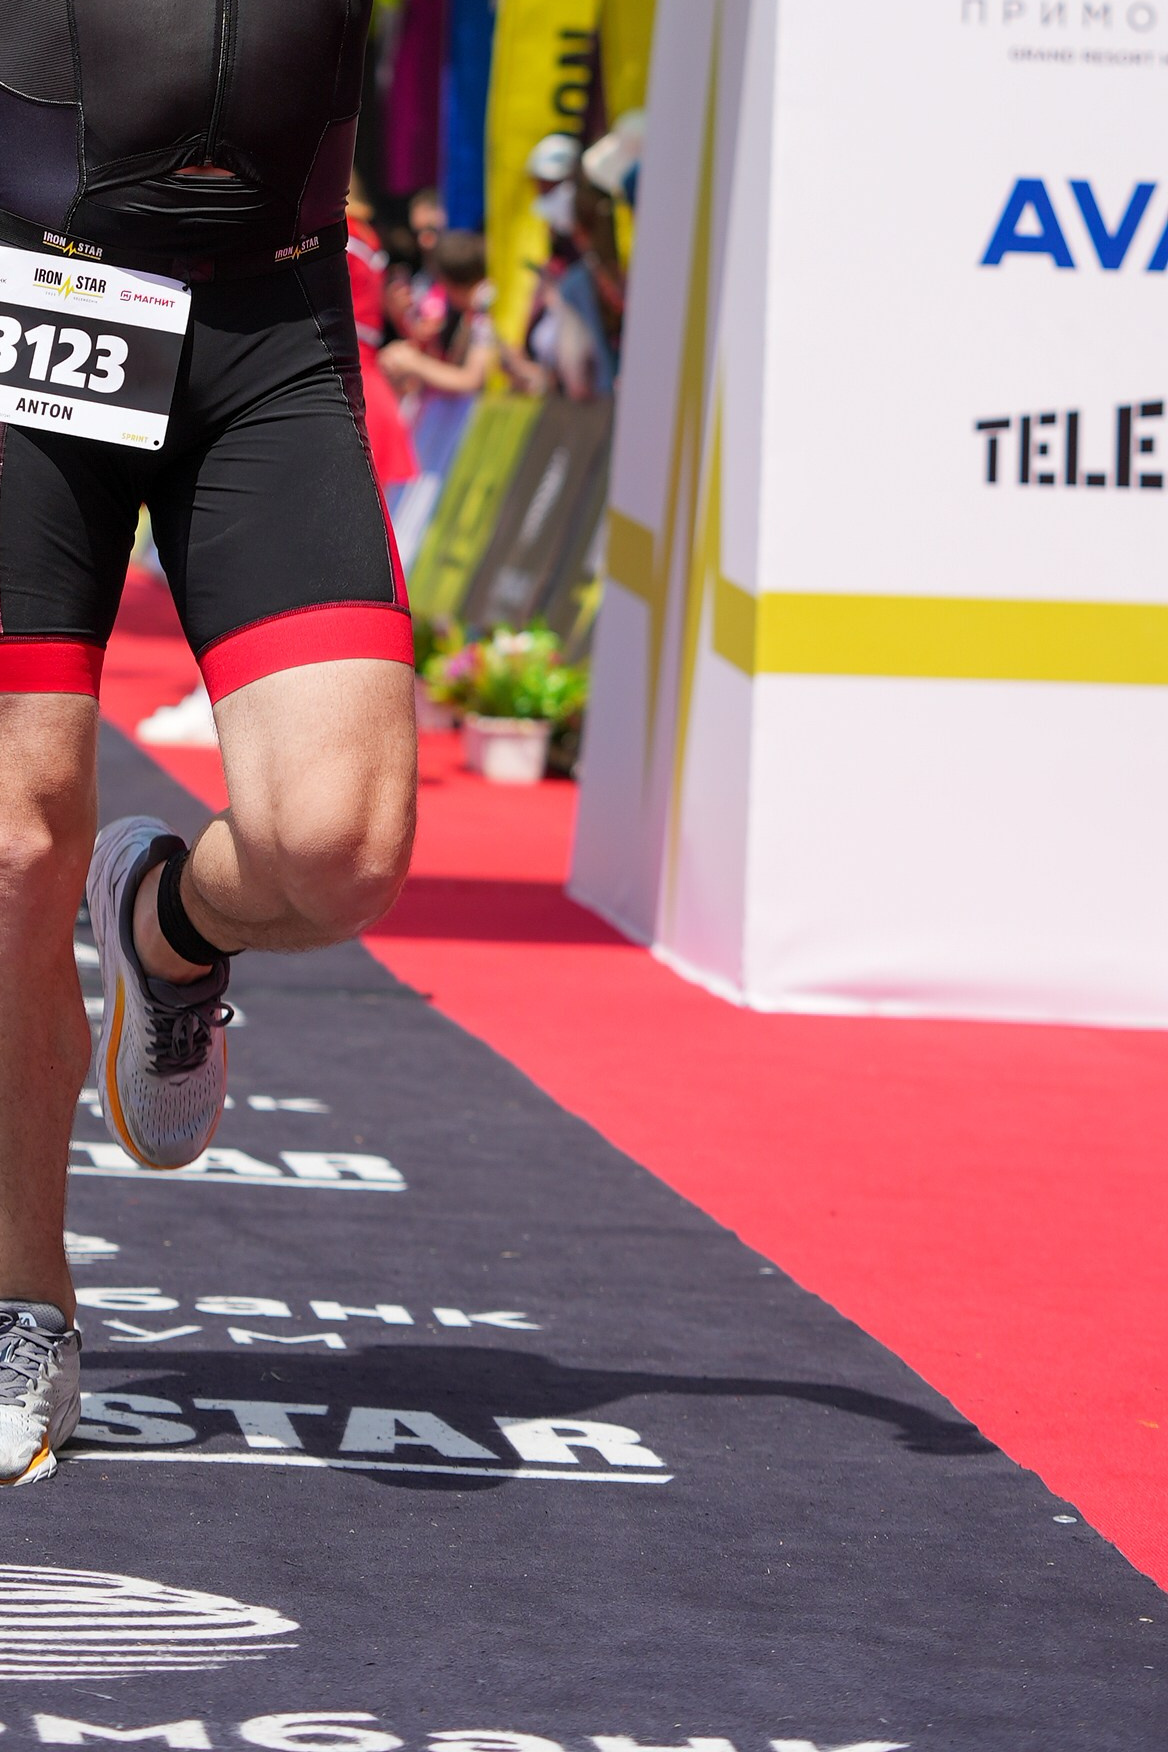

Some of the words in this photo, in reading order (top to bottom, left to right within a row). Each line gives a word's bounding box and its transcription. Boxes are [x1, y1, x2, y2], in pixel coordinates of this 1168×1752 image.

[978, 177, 1168, 273] AV
[43, 231, 66, 247] IRON
[77, 242, 103, 258] STAR
[275, 246, 294, 259] IRON
[301, 236, 319, 251] STAR
[34, 268, 63, 286] IRON
[75, 275, 107, 294] STAR
[133, 293, 175, 308] МАГНИТ
[15, 397, 73, 421] ANTON
[121, 432, 149, 443] SPRINT
[68, 1390, 667, 1469] STAR
